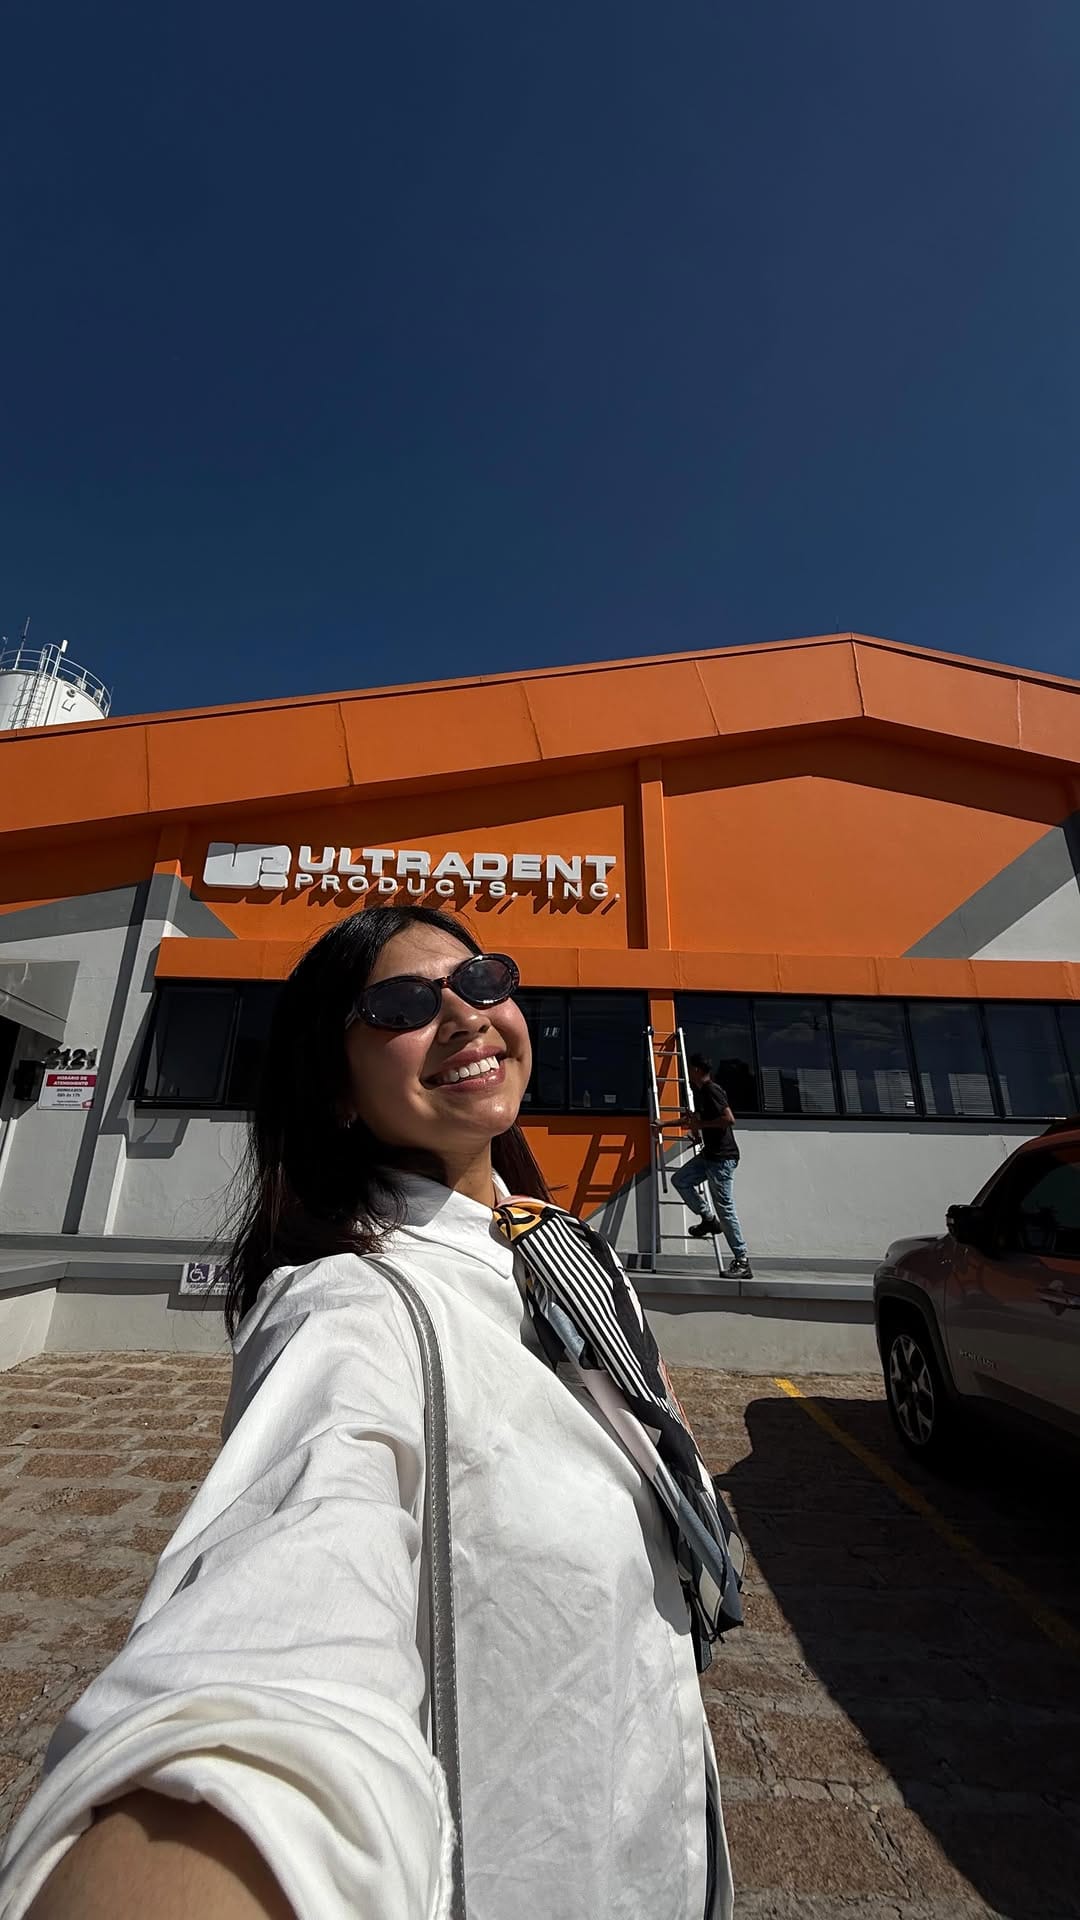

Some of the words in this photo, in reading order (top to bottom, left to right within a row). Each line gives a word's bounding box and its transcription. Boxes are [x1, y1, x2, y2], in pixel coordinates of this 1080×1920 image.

[298, 845, 617, 882] ULTRADENT
[294, 873, 519, 899] PRODUCTS,
[547, 881, 620, 900] INC.
